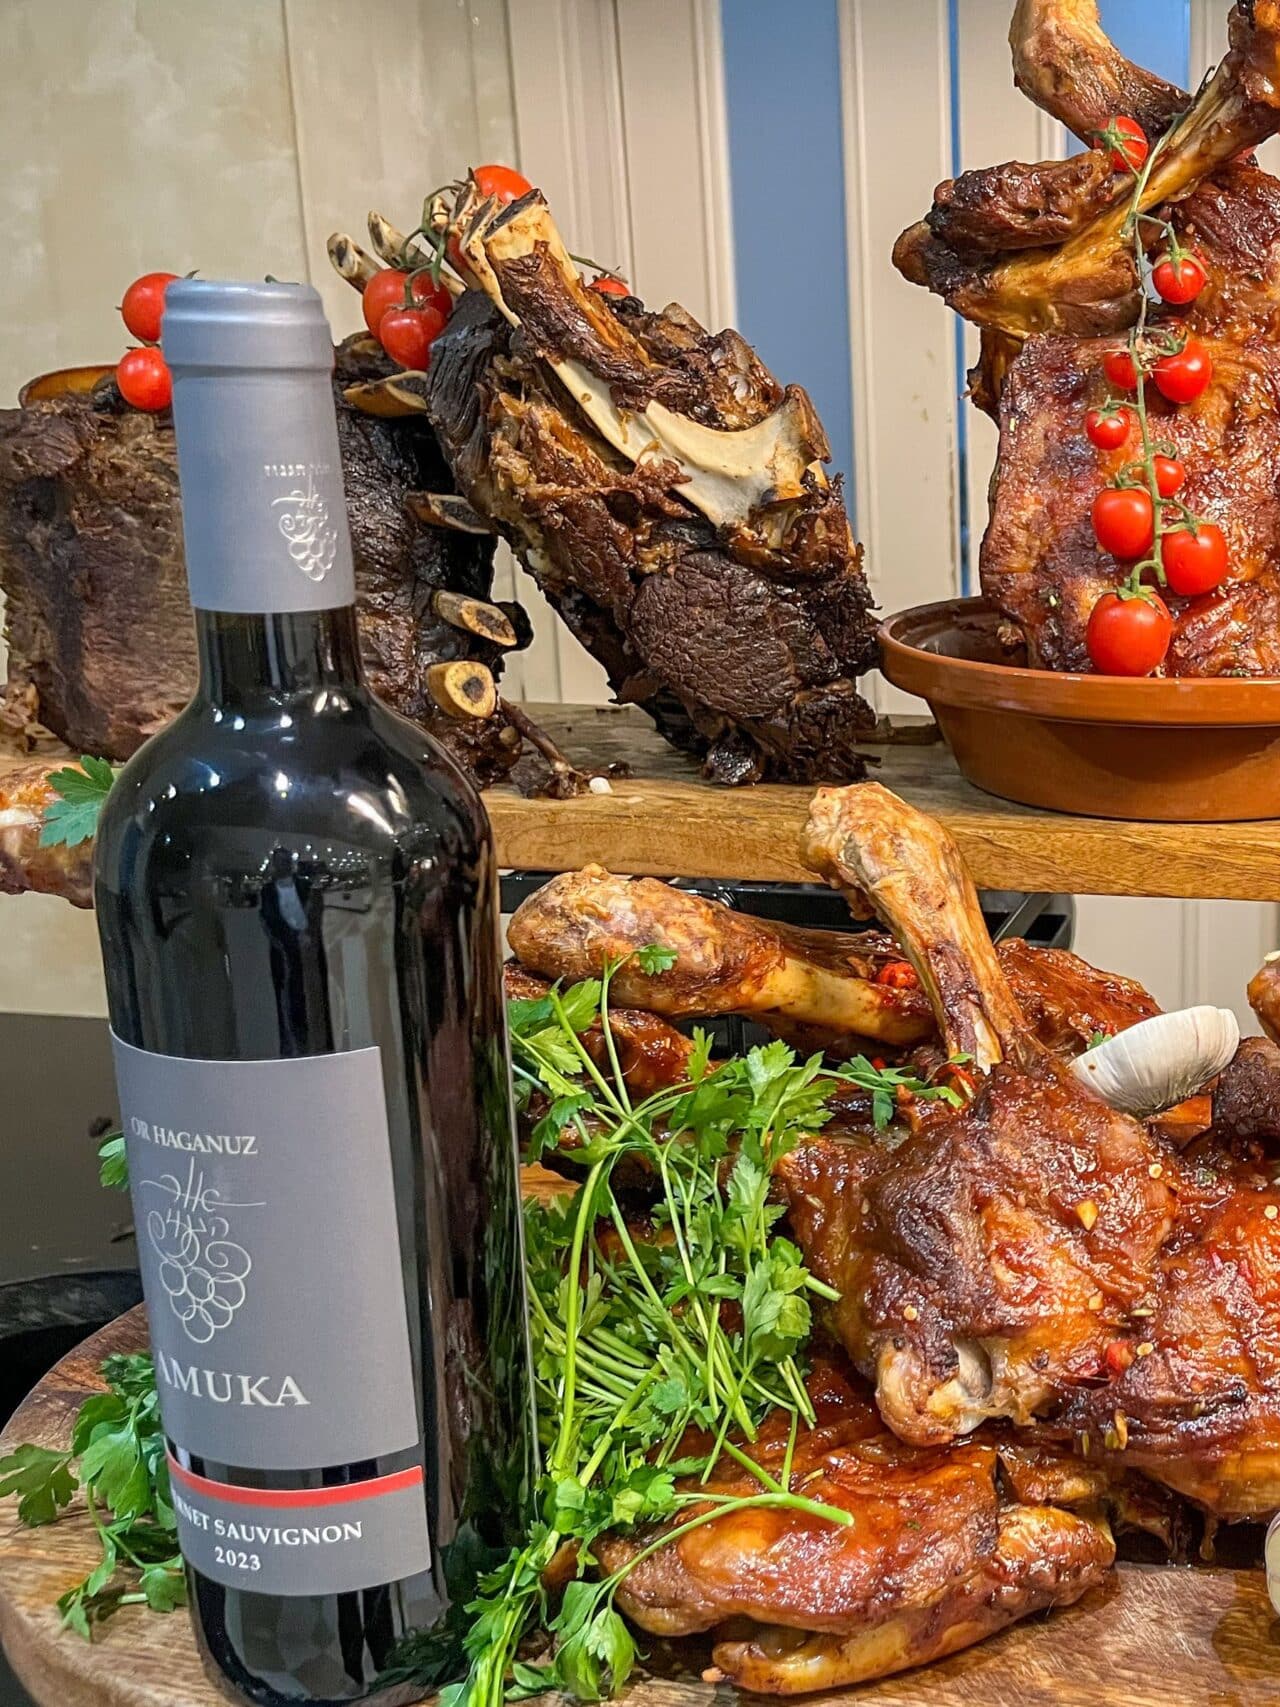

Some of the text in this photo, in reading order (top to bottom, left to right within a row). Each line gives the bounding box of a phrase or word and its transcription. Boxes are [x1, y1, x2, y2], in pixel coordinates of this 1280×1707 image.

[130, 1116, 258, 1155] OR HAGANUZ
[214, 1519, 363, 1546] SAUVIGNON
[214, 1546, 262, 1571] 2023
